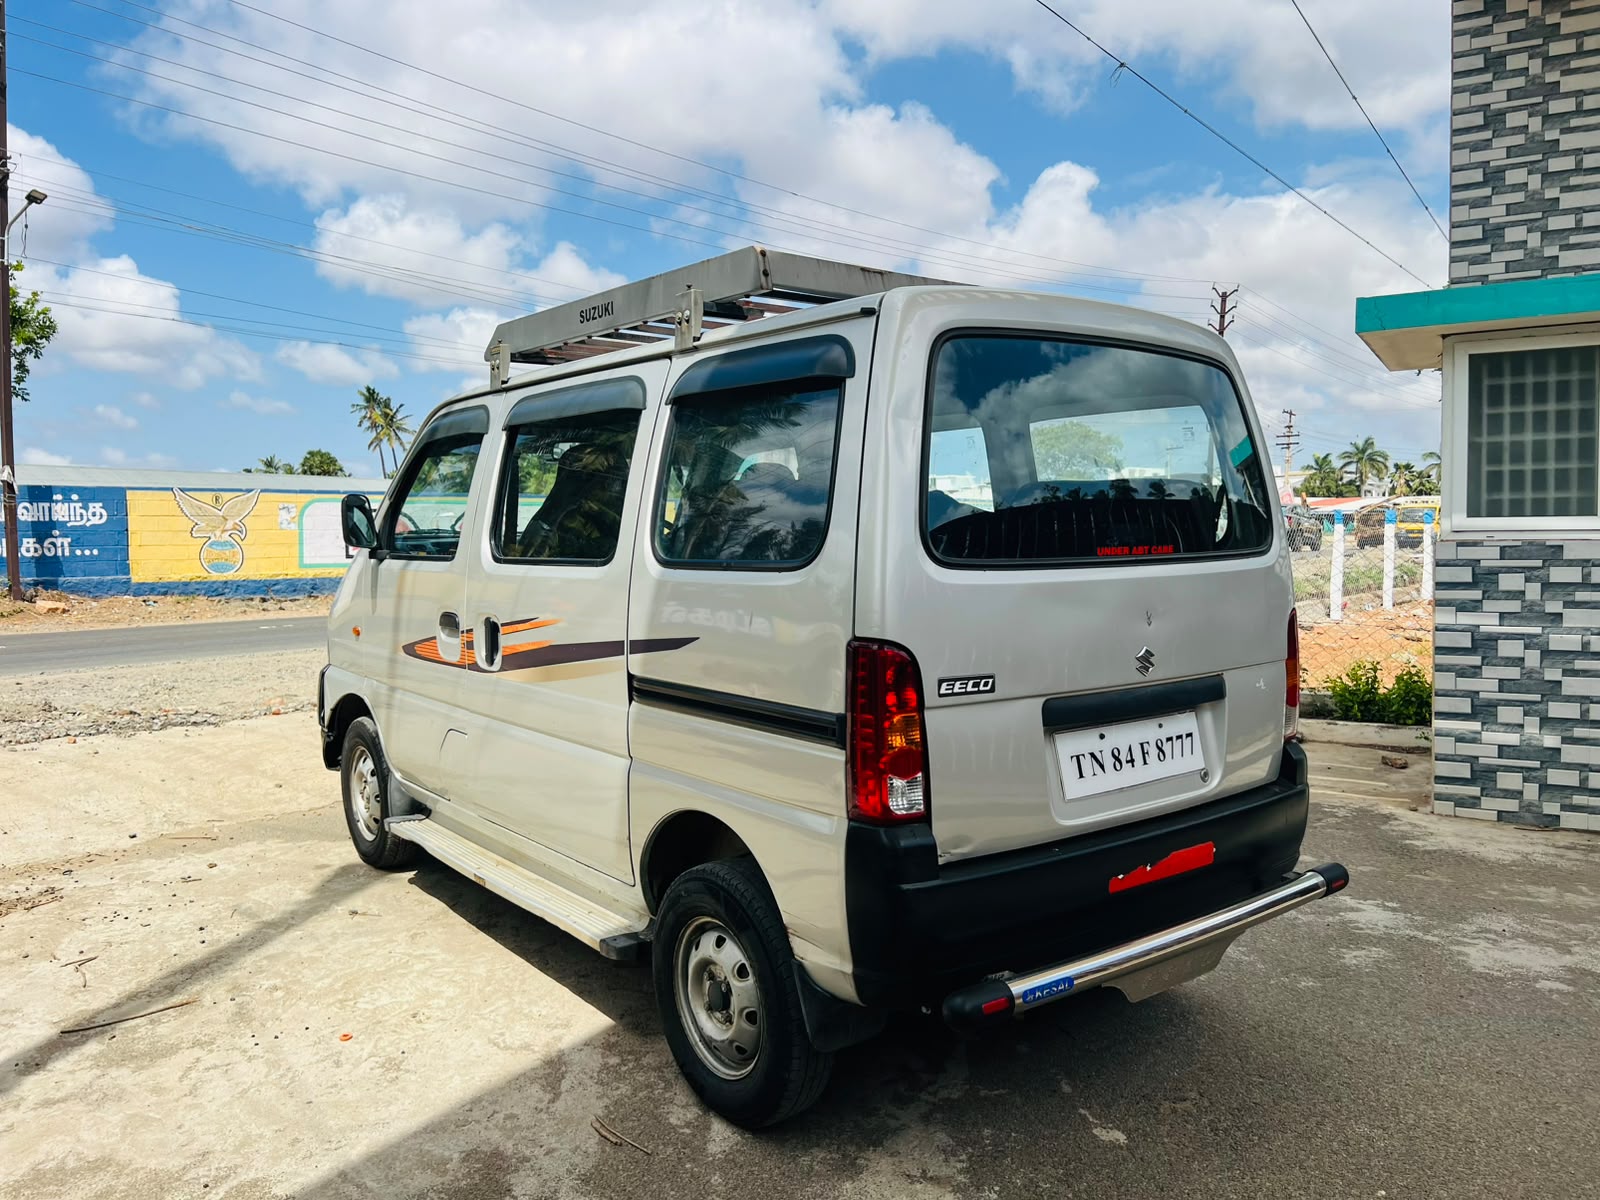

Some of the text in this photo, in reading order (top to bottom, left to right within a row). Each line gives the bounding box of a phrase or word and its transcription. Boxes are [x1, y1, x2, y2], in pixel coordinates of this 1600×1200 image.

[579, 300, 614, 324] SUZUKI
[1097, 546, 1130, 556] UNDER
[939, 678, 994, 694] EECO
[1070, 732, 1194, 779] TN 84 F 8777
